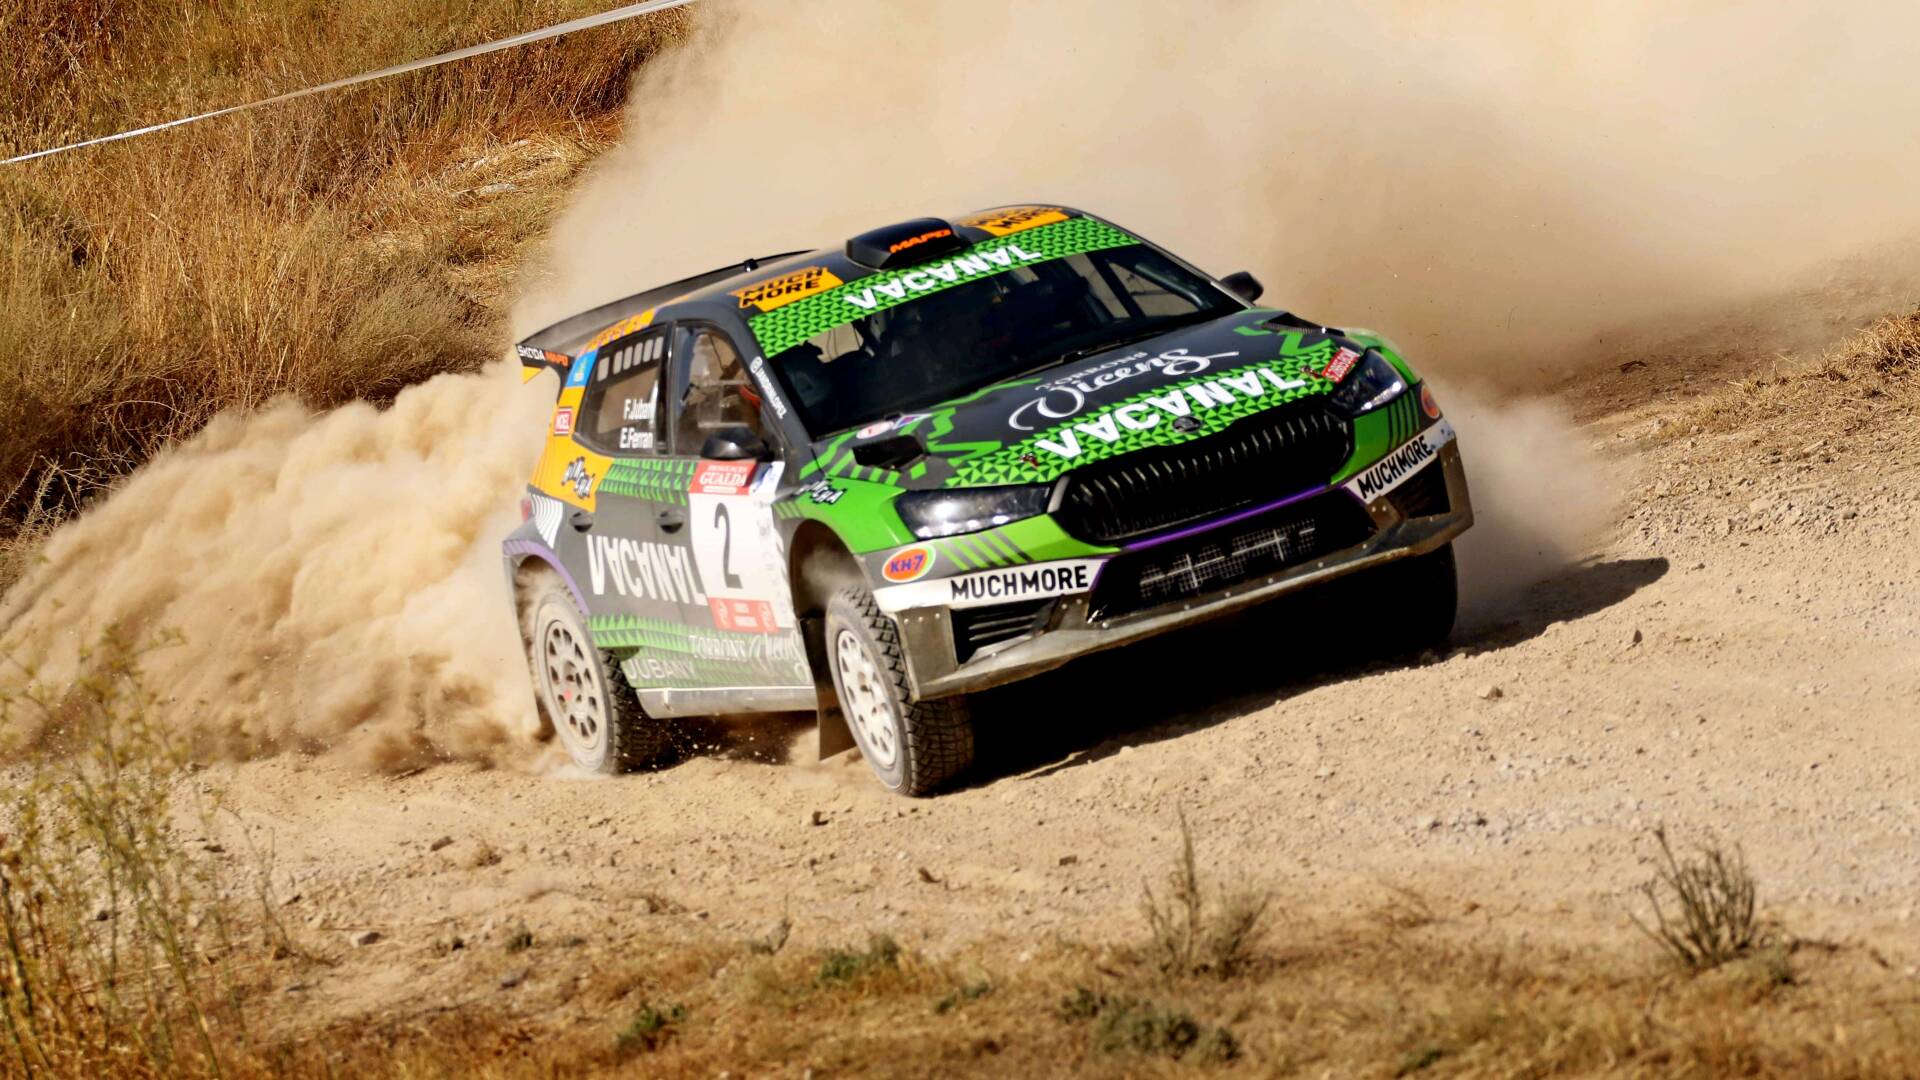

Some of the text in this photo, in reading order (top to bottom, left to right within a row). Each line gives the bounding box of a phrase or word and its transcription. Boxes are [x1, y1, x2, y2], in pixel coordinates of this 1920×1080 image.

[742, 278, 820, 307] MORE
[744, 268, 824, 296] MUCH
[1357, 434, 1434, 500] MUCHMORE
[713, 502, 743, 590] 2
[951, 565, 1089, 600] MUCHMORE
